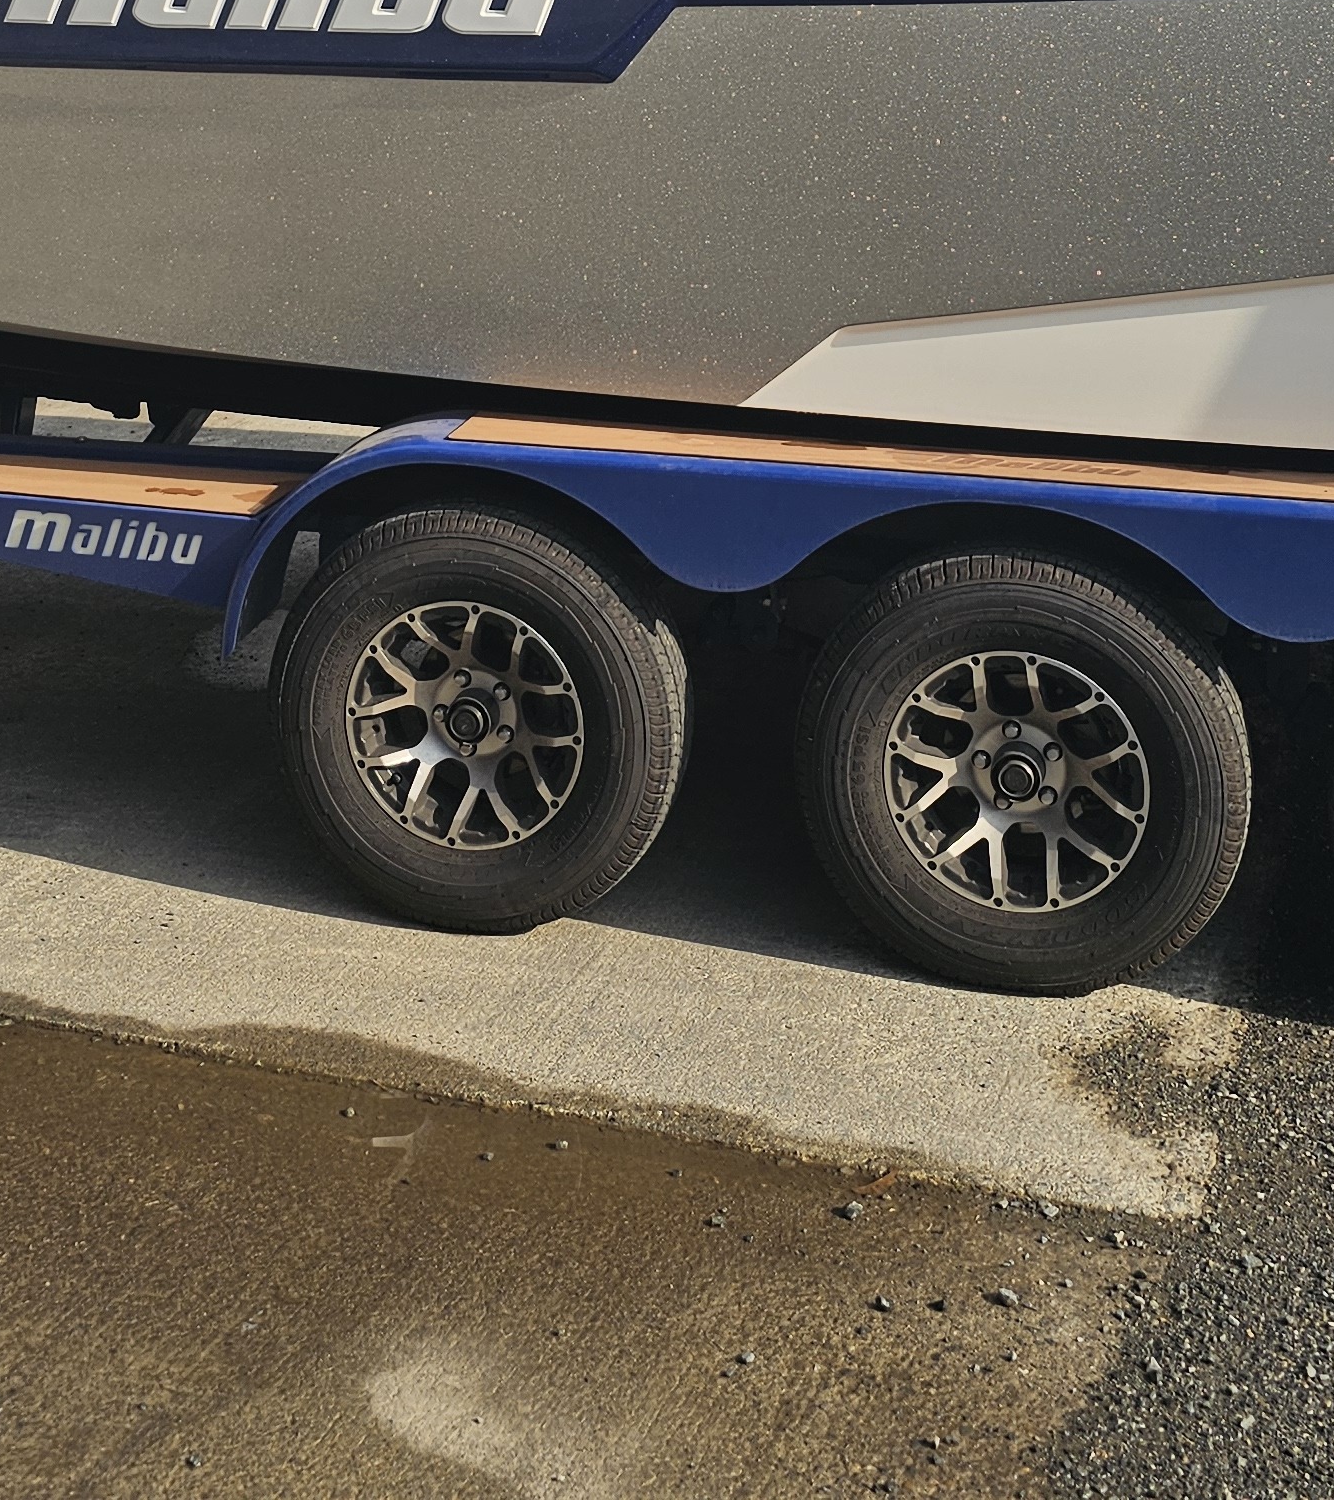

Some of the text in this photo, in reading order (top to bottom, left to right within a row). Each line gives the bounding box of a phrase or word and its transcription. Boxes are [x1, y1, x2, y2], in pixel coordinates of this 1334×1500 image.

[4, 509, 204, 565] Malibu
[850, 724, 871, 784] 65 PSI
